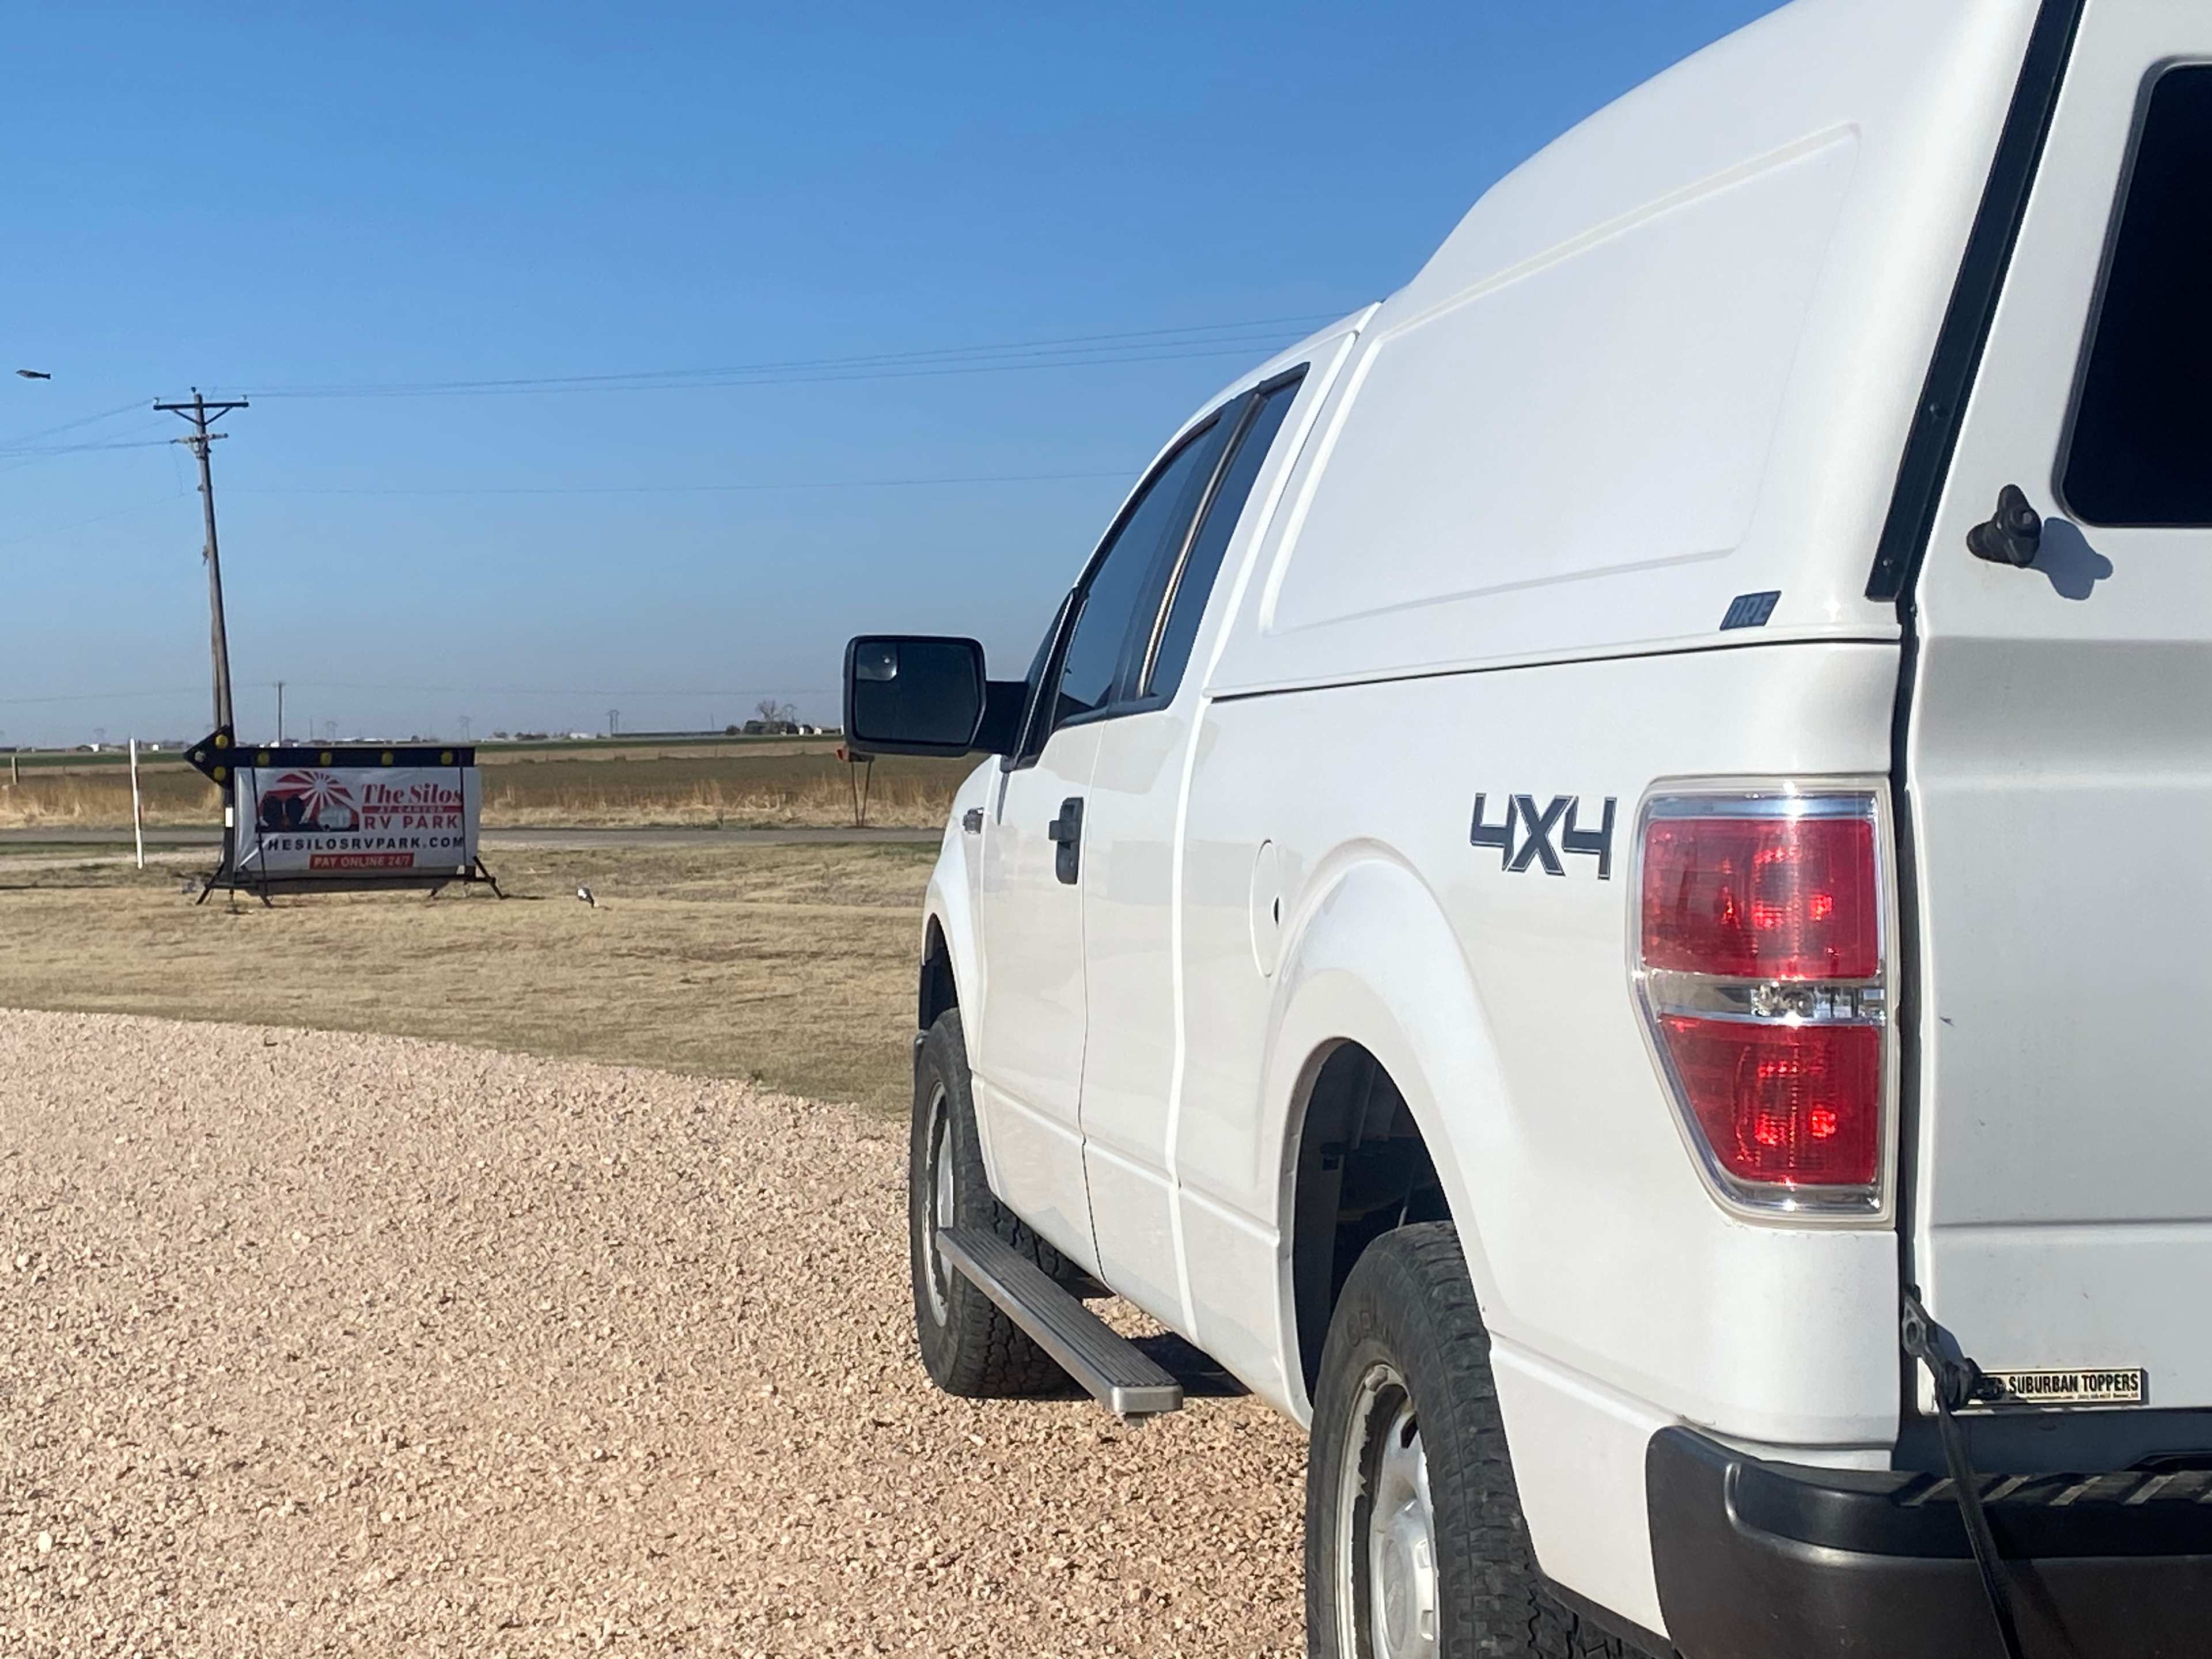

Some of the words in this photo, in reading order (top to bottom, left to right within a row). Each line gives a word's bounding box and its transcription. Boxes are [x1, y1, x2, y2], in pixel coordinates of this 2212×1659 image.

[362, 784, 404, 803] The
[365, 816, 391, 830] RV
[403, 815, 458, 830] PARK
[1470, 793, 1617, 880] 4X4
[314, 856, 338, 868] PAY
[340, 855, 385, 868] ONLINE
[388, 854, 411, 866] 24/7
[2008, 1375, 2078, 1394] SUBURBAN
[2081, 1373, 2139, 1392] TOPPERS
